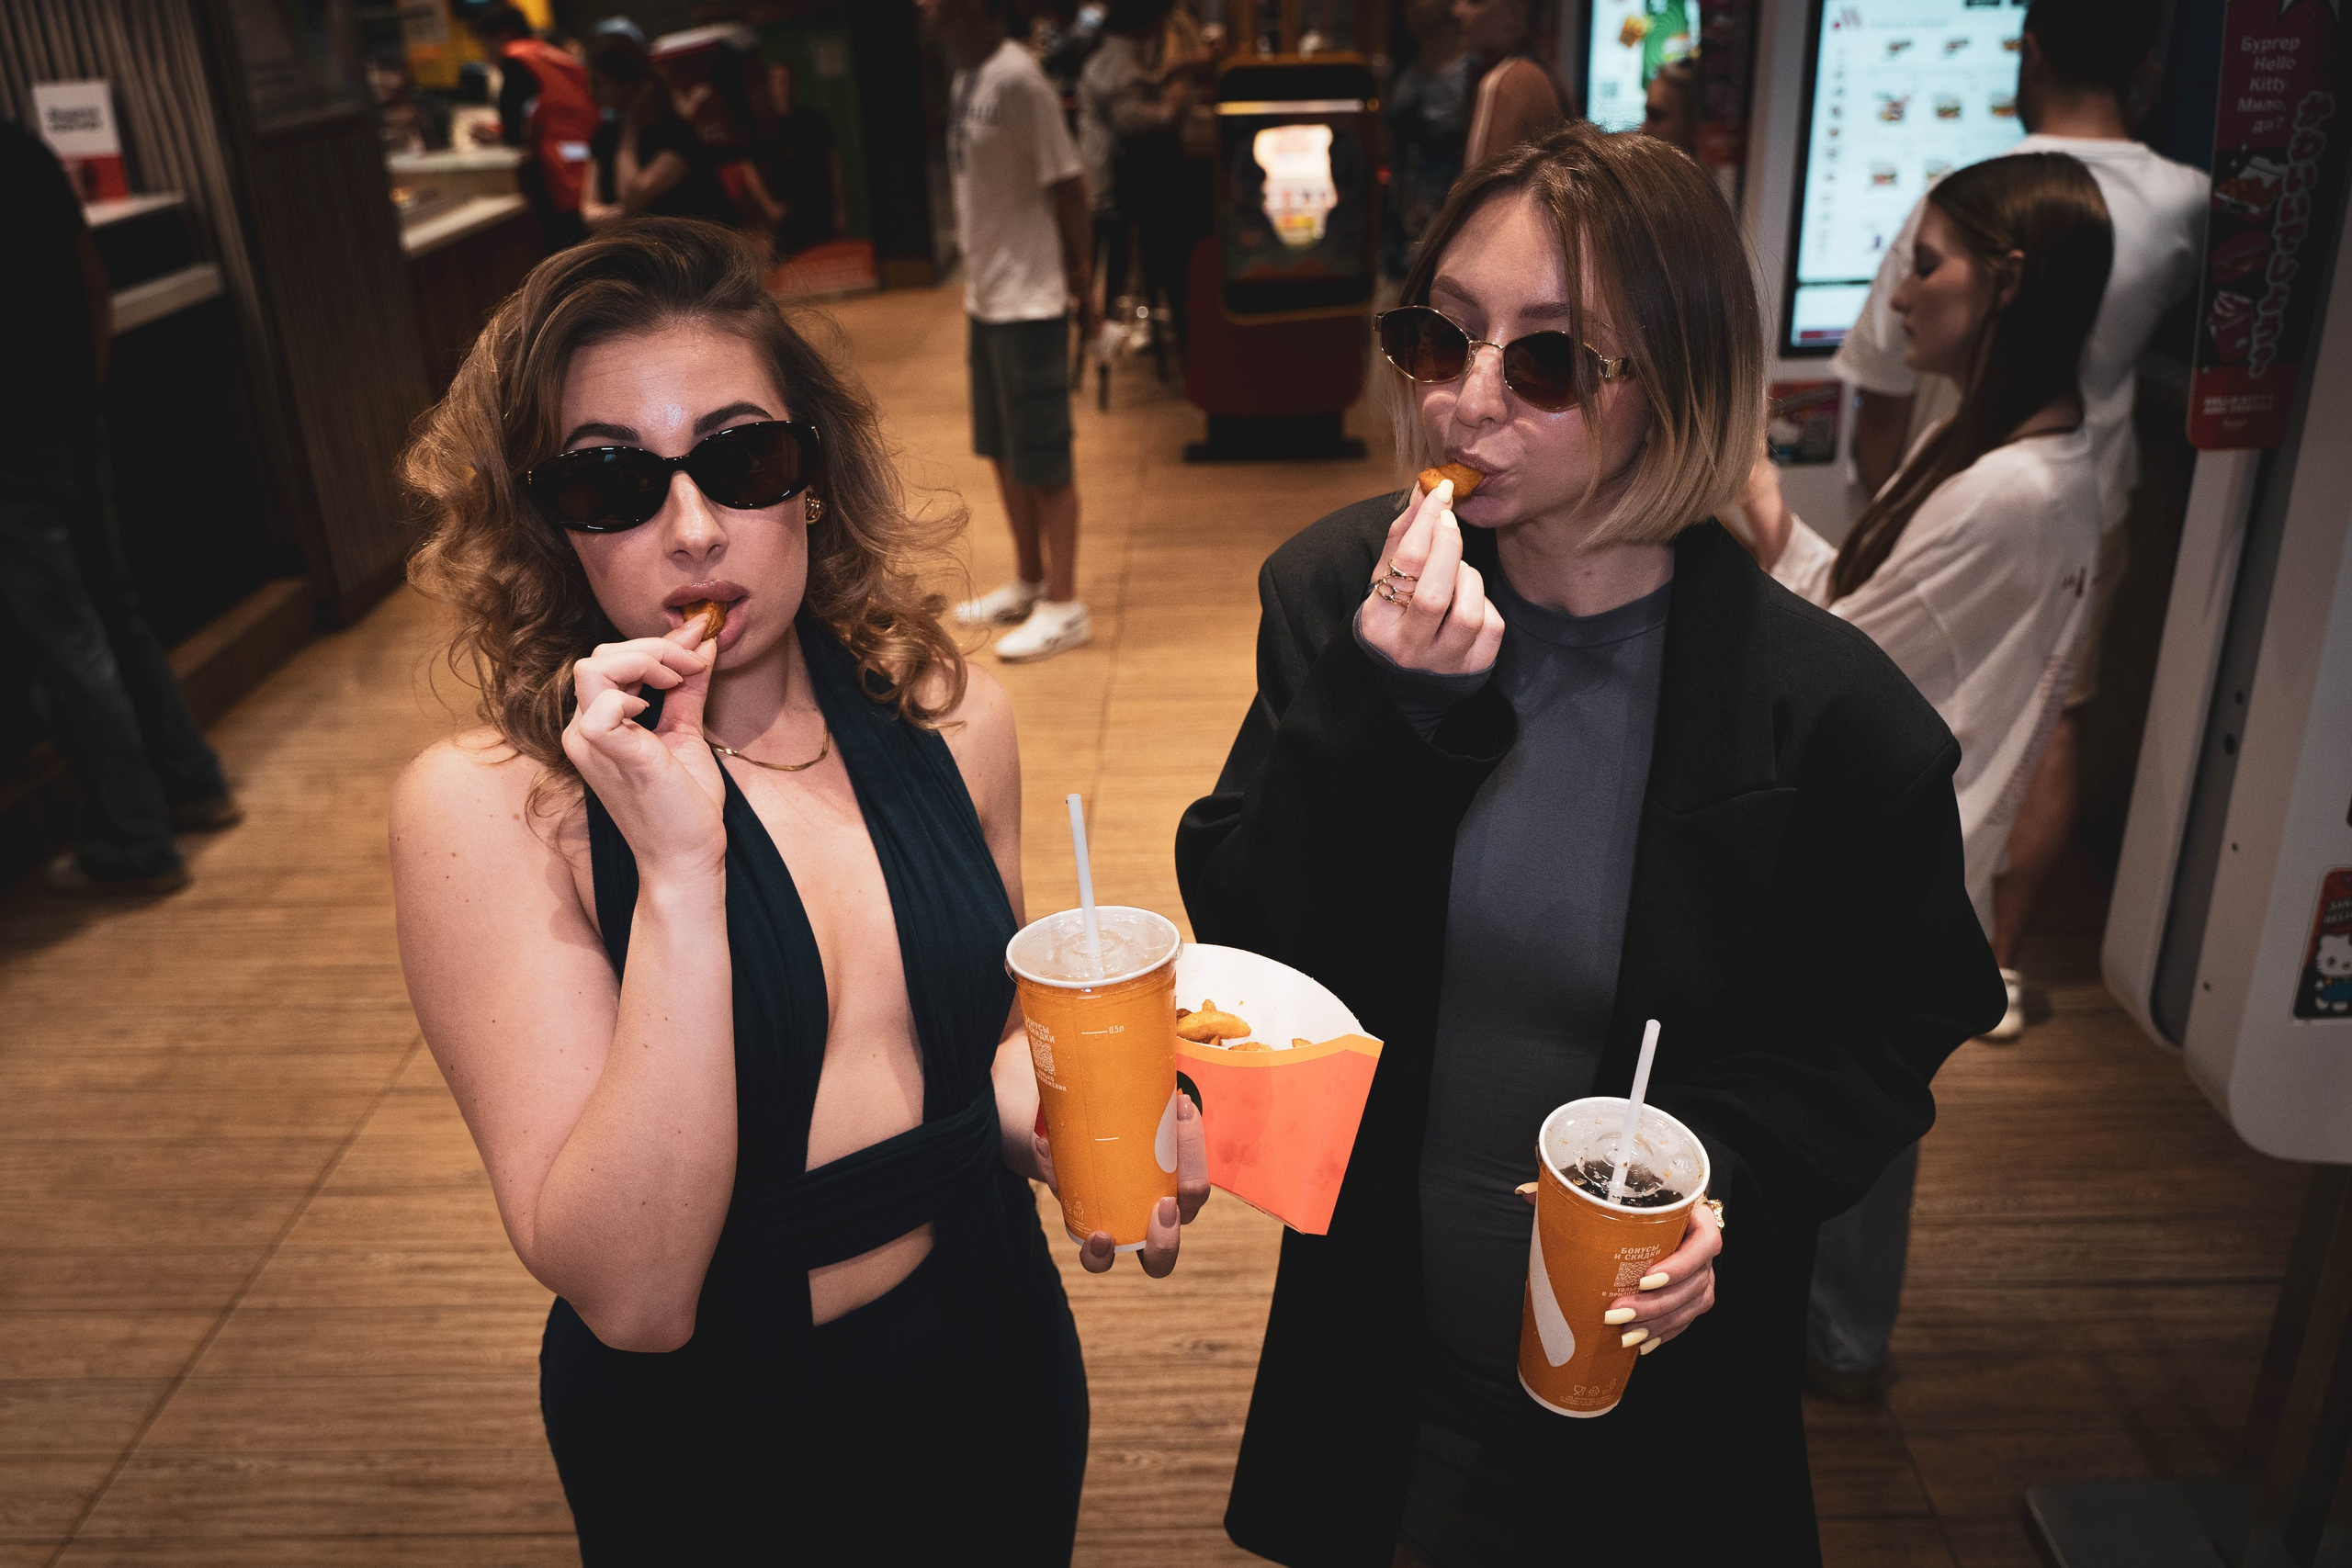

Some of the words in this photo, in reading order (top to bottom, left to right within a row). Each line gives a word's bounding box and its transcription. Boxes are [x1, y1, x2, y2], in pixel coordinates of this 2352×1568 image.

[2240, 35, 2301, 54] Бургер
[2253, 55, 2297, 72] Hello
[2251, 115, 2286, 135] да?
[1621, 1244, 1659, 1254] БОНУСЫ
[1624, 1249, 1661, 1260] СКИДКИ
[1609, 1290, 1639, 1298] ПРИЛОЖ
